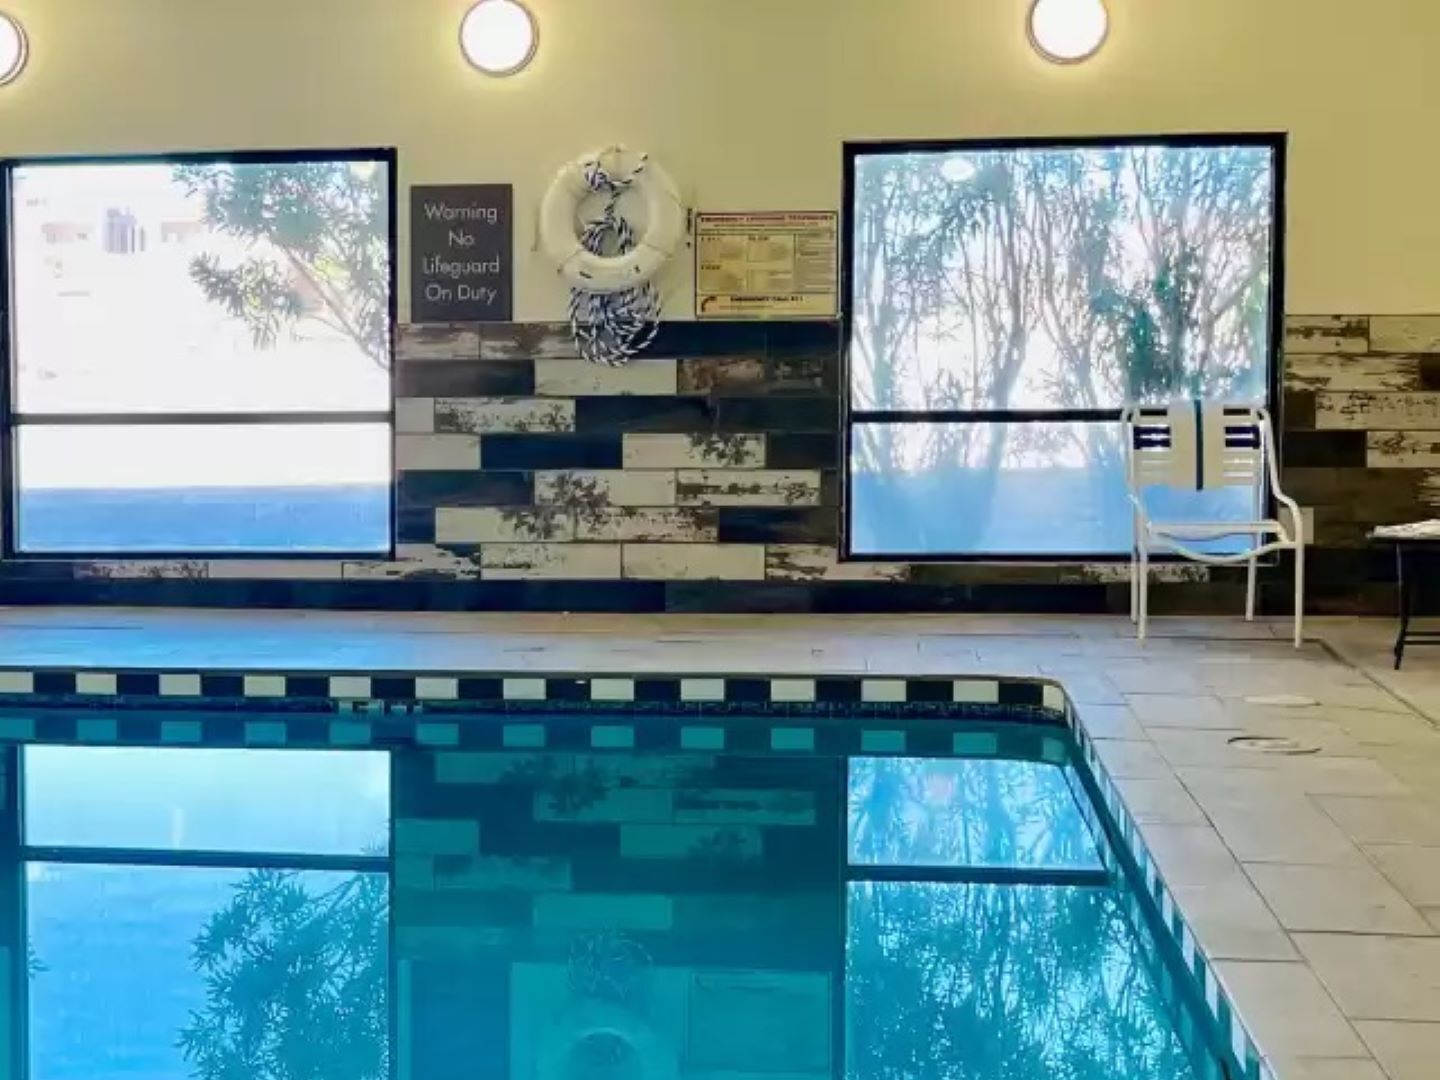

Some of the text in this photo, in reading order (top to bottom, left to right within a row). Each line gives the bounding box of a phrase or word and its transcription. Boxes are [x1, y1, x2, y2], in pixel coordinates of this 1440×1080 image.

[423, 202, 498, 225] Warning
[448, 228, 475, 247] No
[422, 254, 500, 279] Lifeguard
[425, 283, 497, 306] On Duty
